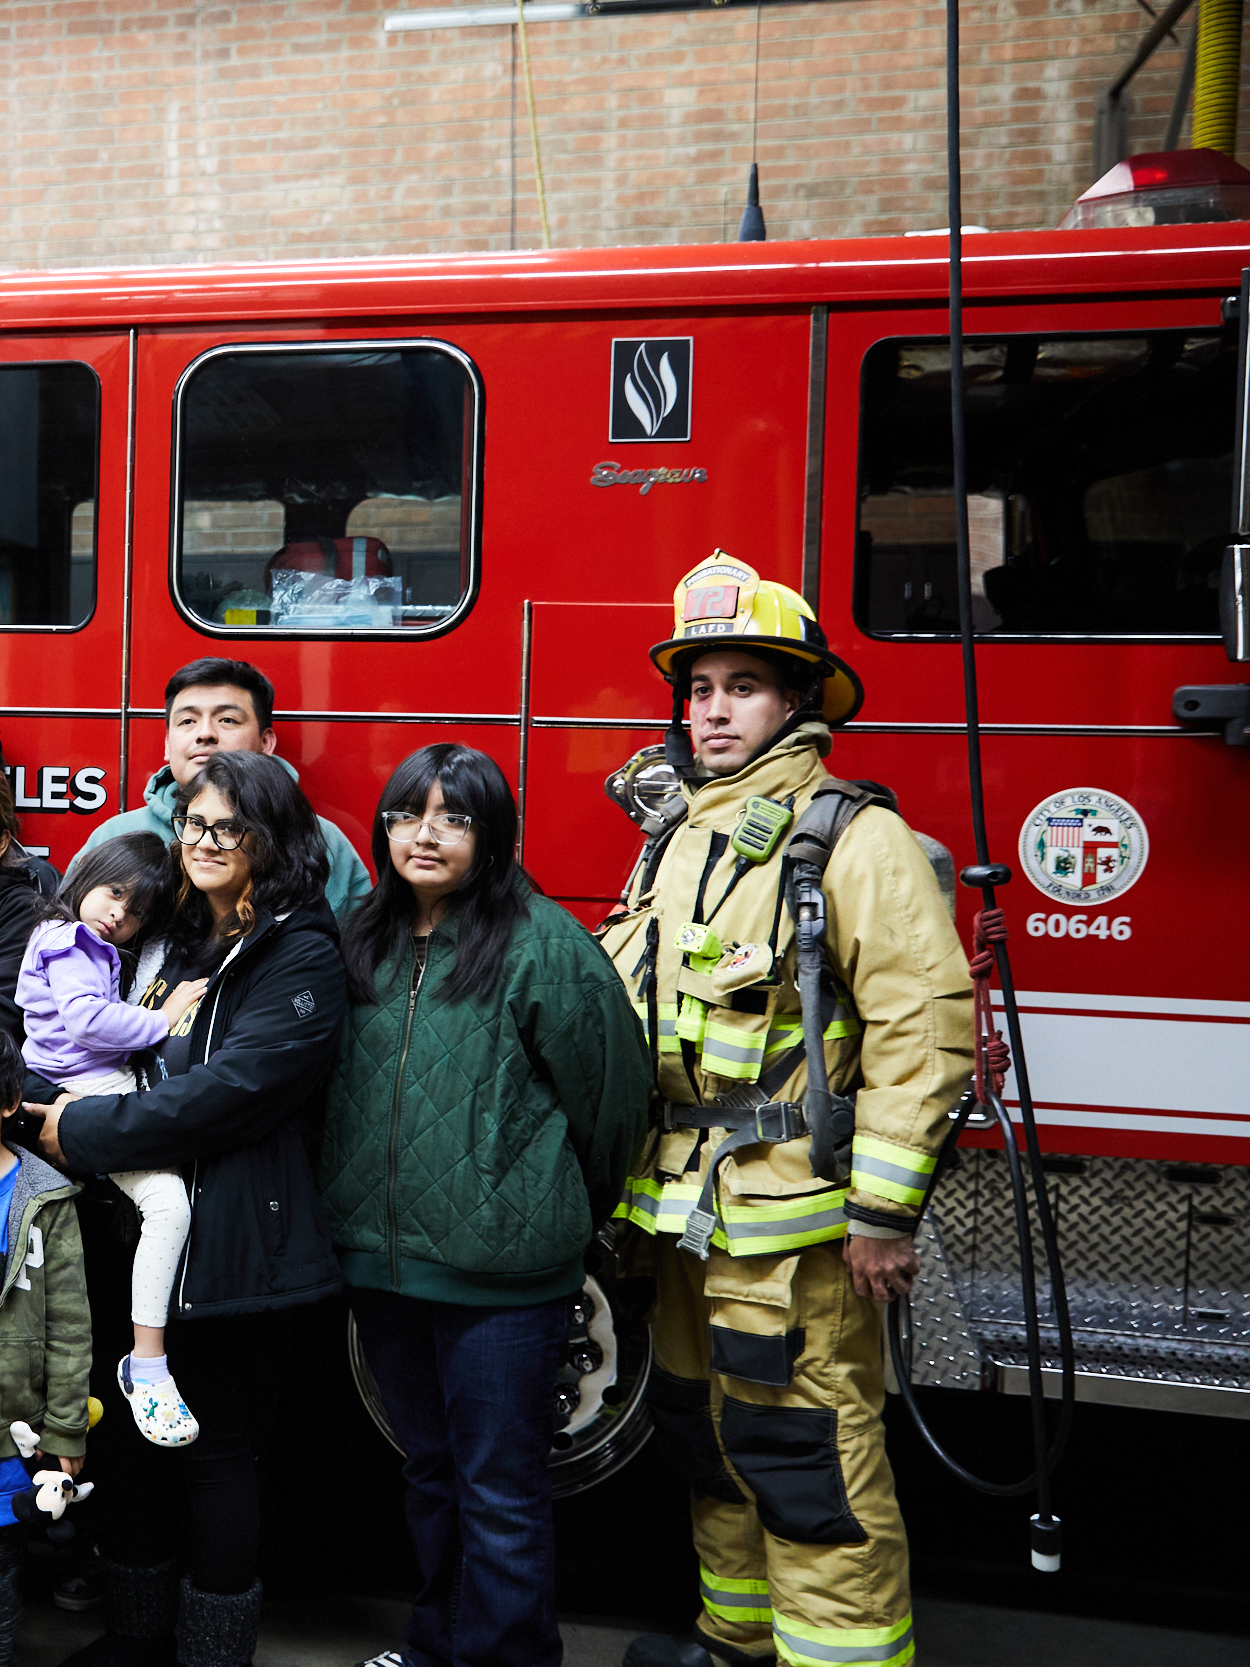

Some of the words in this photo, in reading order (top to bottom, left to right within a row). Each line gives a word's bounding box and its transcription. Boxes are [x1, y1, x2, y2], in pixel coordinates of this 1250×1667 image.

[686, 565, 751, 587] PROBATIONARY
[690, 586, 725, 618] 72
[690, 623, 726, 635] LAFD
[1032, 807, 1051, 827] CITY
[1053, 798, 1065, 808] OF
[1071, 795, 1091, 803] LOS
[1095, 797, 1135, 829] ANGELES
[1026, 912, 1133, 941] 60646
